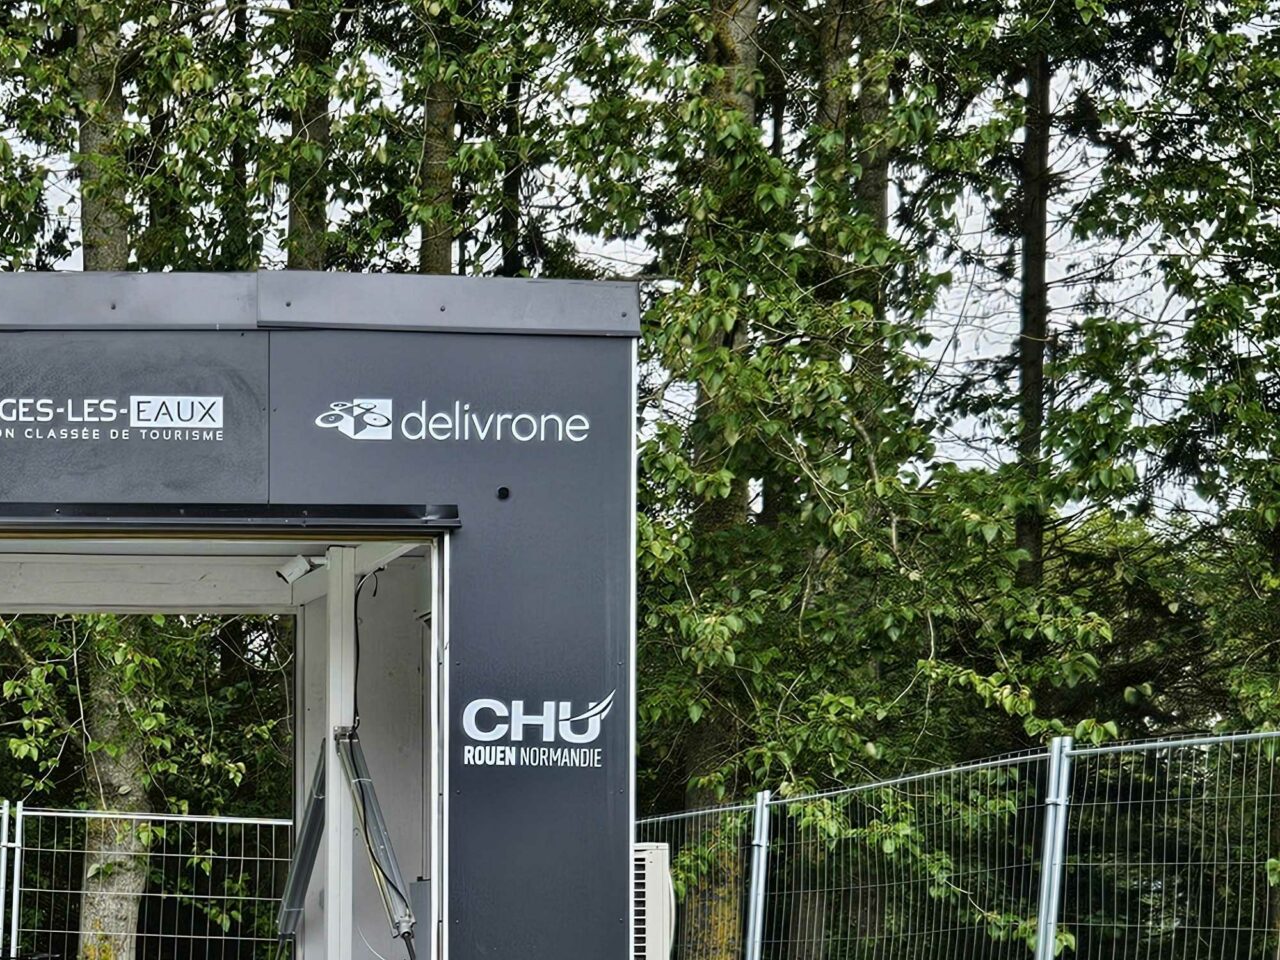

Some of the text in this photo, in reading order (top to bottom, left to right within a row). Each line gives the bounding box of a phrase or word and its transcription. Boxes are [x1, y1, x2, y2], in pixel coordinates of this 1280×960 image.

[24, 425, 100, 440] CLASSÉE
[109, 427, 130, 440] DE
[139, 428, 224, 441] TOURISME
[400, 399, 591, 442] delivrone
[462, 696, 604, 743] CHU
[464, 745, 602, 767] ROUEN NORMANDIE
